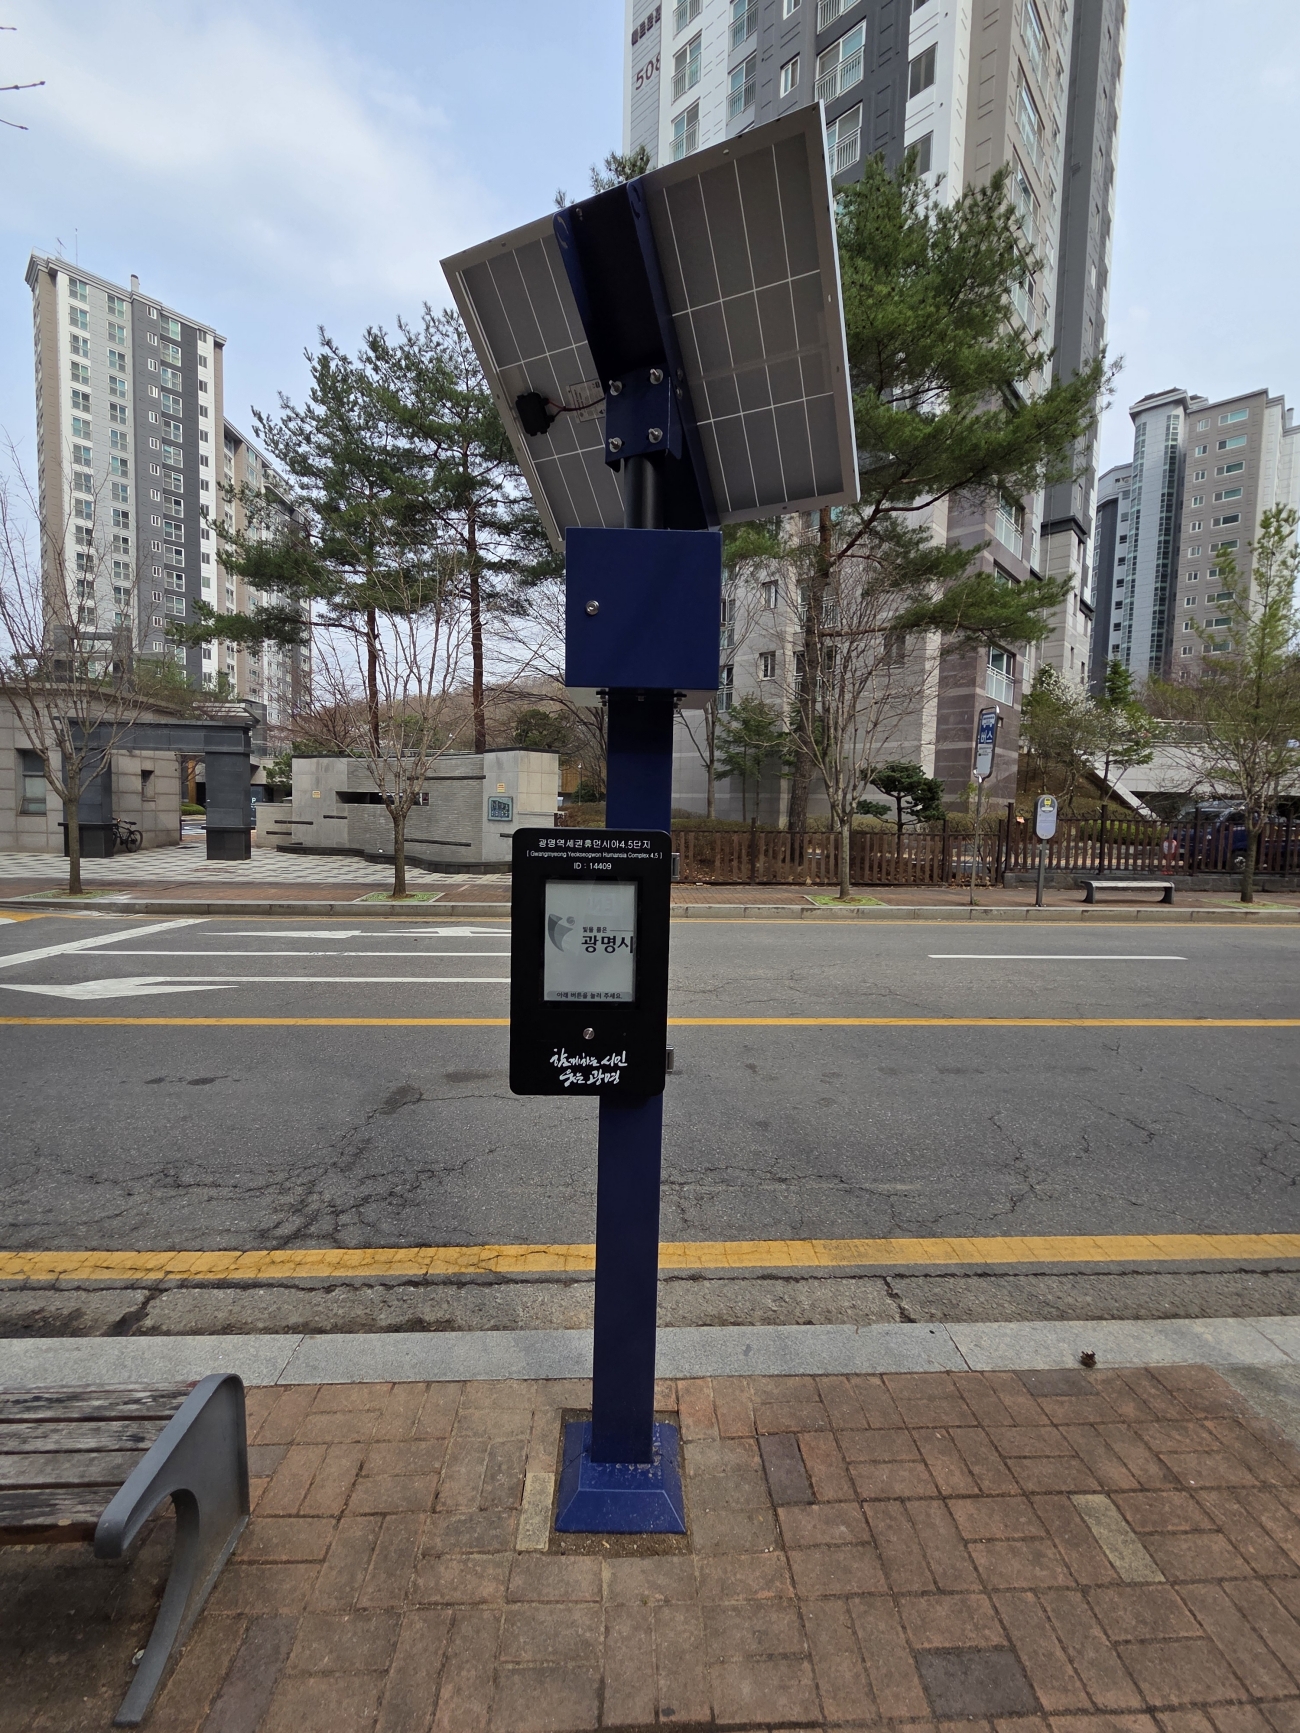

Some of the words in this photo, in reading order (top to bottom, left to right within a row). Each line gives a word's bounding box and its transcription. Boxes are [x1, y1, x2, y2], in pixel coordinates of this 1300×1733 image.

[589, 862, 612, 870] 14409
[581, 935, 634, 954] 광명시
[556, 991, 569, 999] 아래
[570, 991, 588, 1000] 버튼을
[586, 1069, 620, 1086] 광명
